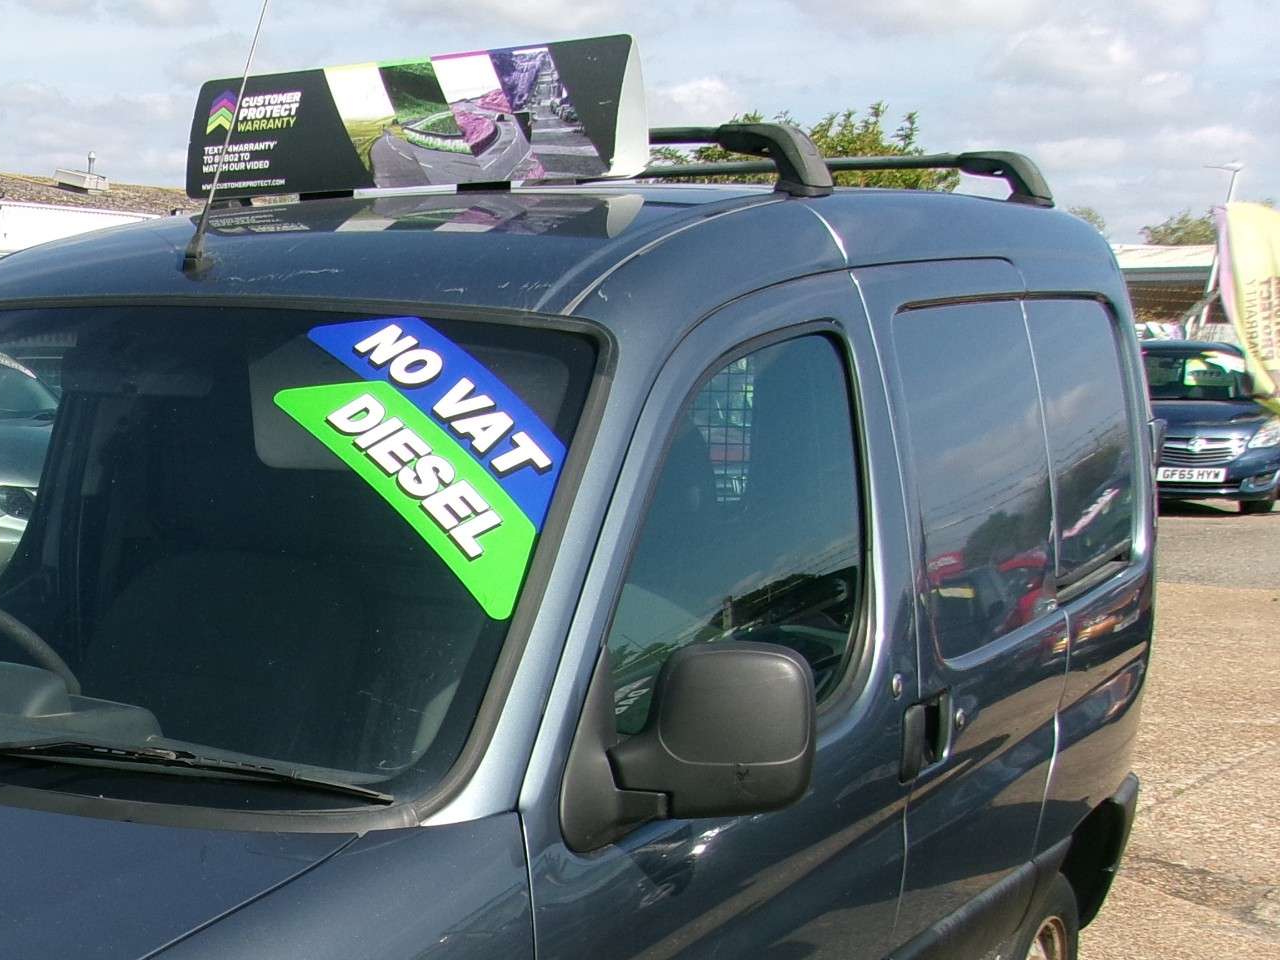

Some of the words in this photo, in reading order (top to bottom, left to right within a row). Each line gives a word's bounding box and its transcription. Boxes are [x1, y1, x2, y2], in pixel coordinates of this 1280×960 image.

[241, 91, 302, 108] CUSTOMER
[238, 103, 300, 121] PROTECT
[237, 116, 297, 132] WARRANTY
[202, 155, 213, 164] TO
[214, 153, 239, 164] 8802
[240, 153, 250, 161] TO
[203, 146, 224, 155] TEXT
[202, 163, 229, 173] WATH
[229, 161, 245, 171] OUR
[245, 160, 270, 170] VIDEO
[353, 323, 444, 387] NO
[432, 377, 553, 477] VAT
[325, 393, 504, 562] DIESEL
[1162, 469, 1194, 479] GF65
